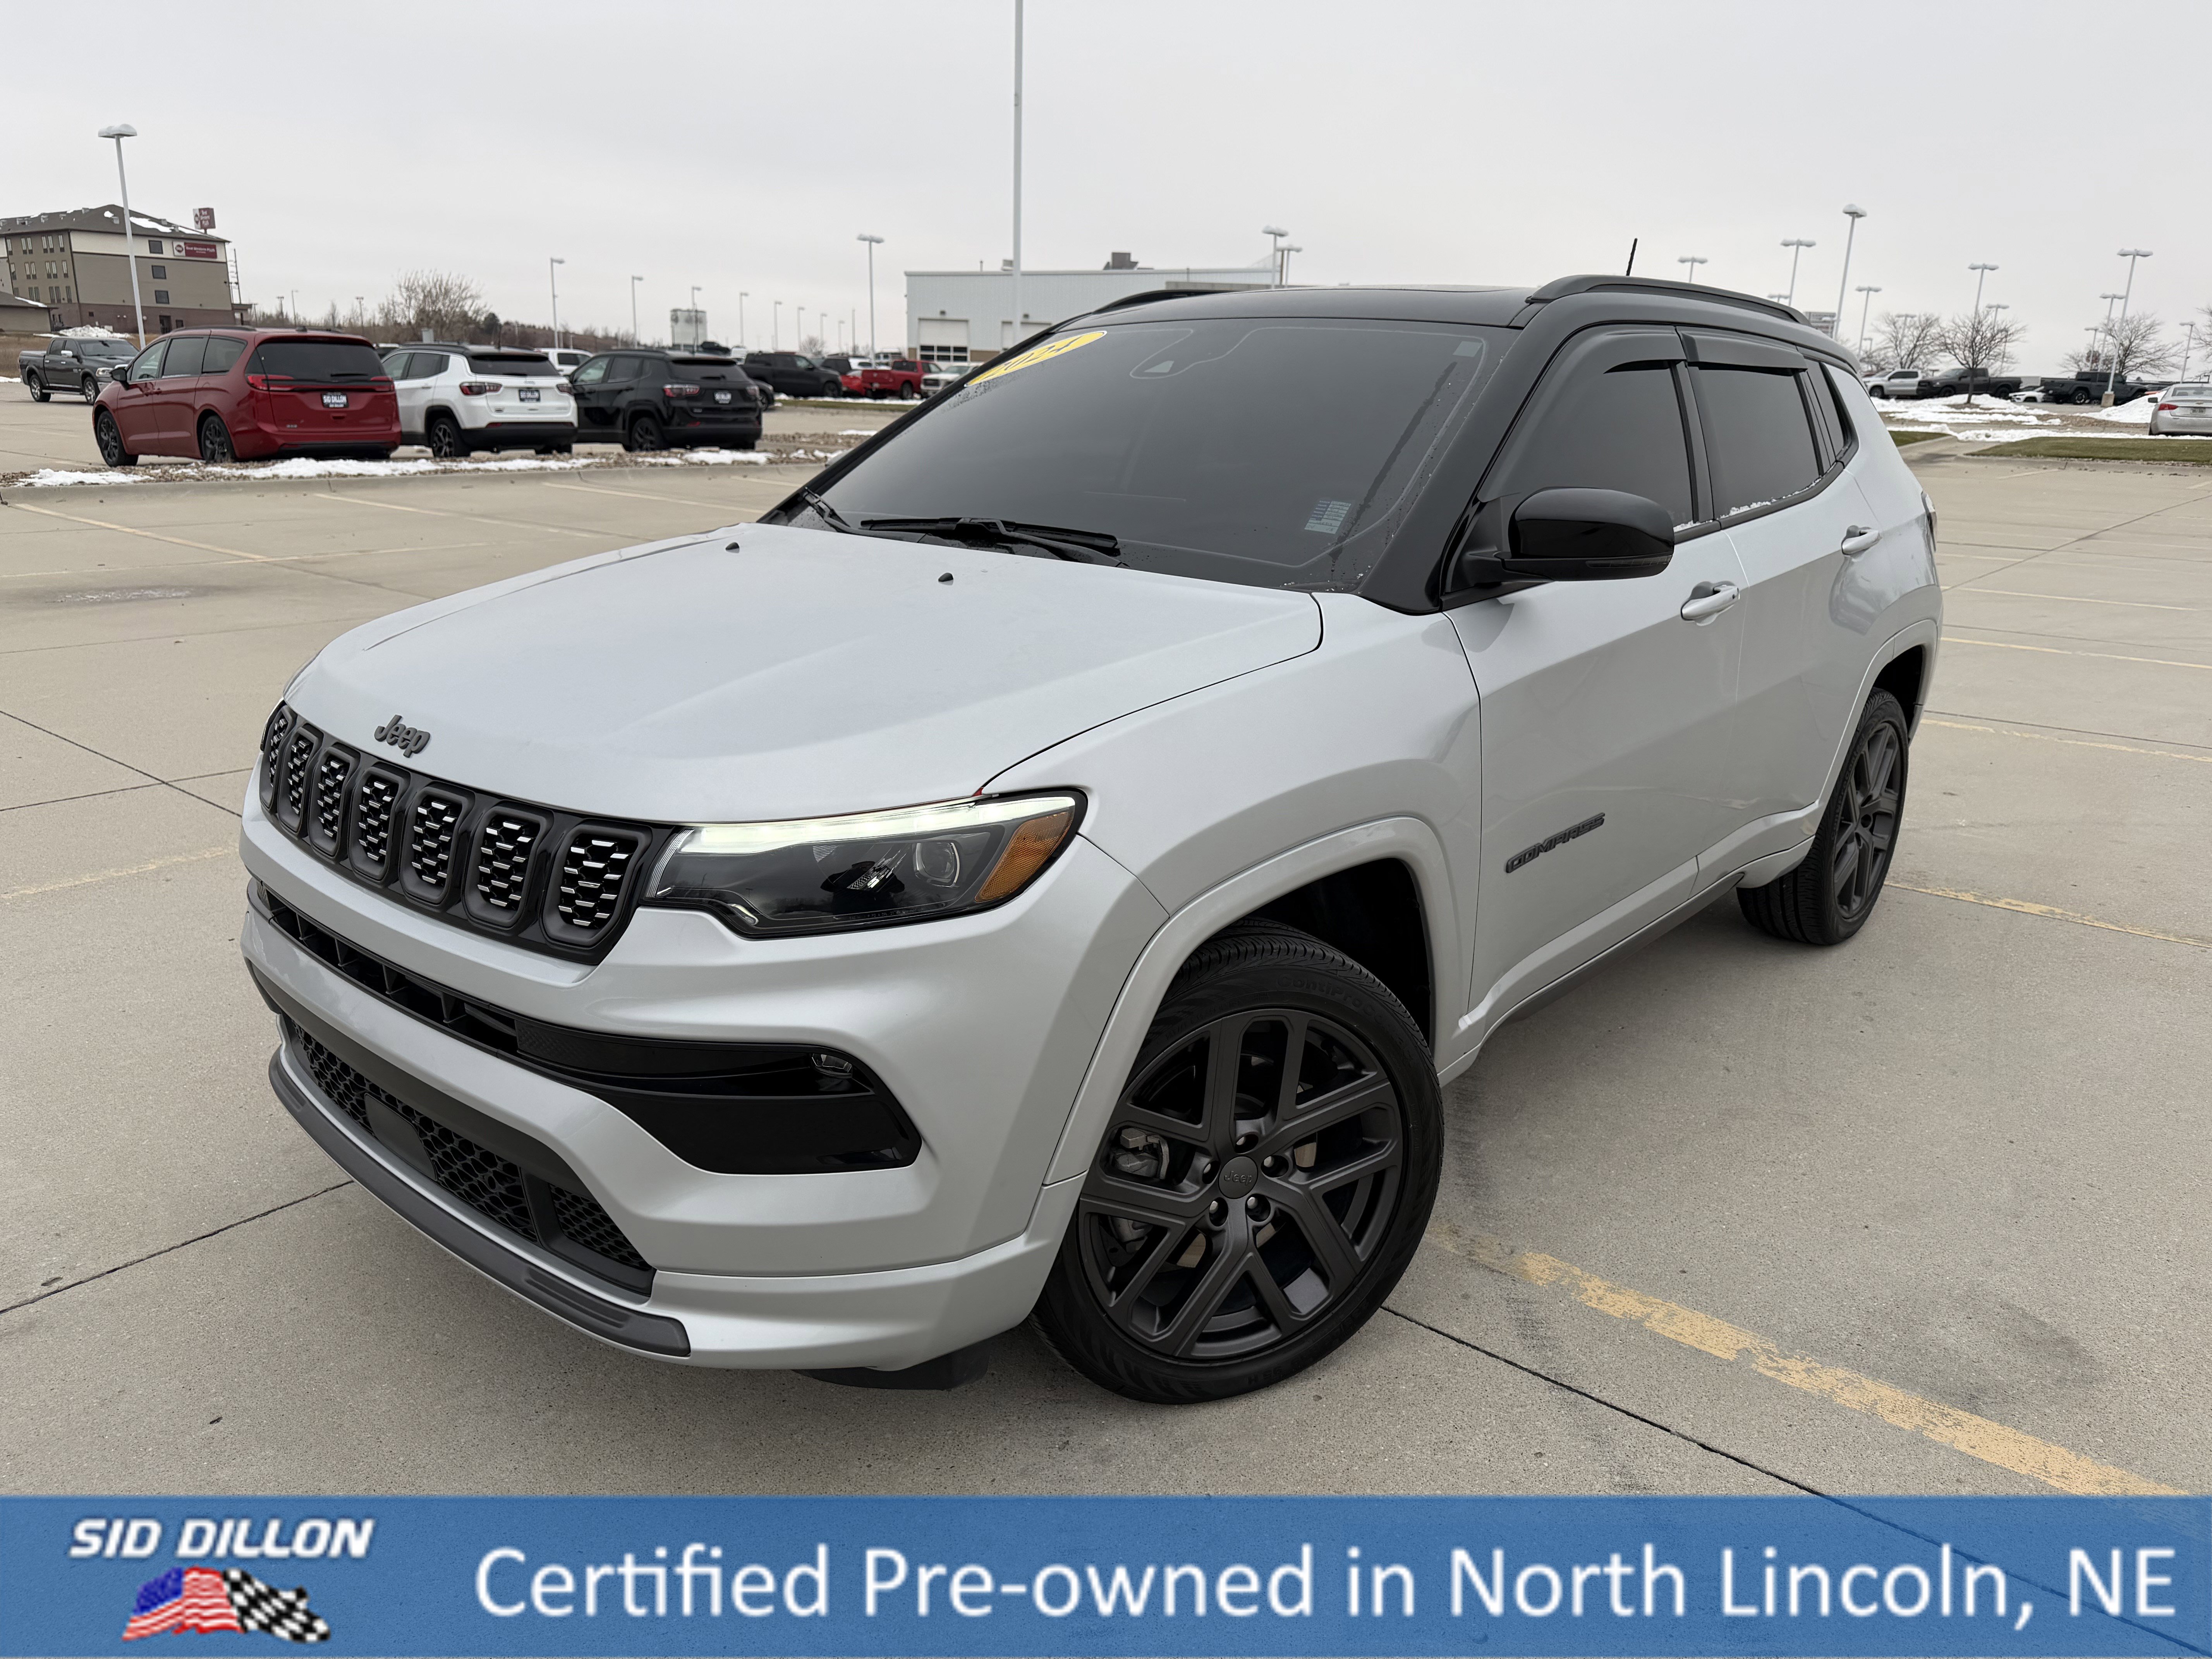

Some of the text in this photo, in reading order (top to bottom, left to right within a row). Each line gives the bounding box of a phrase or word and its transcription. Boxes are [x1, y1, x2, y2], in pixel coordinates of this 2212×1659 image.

[374, 714, 431, 758] Jeep
[1506, 812, 1606, 873] COMPASS
[1224, 1170, 1253, 1186] Jeep
